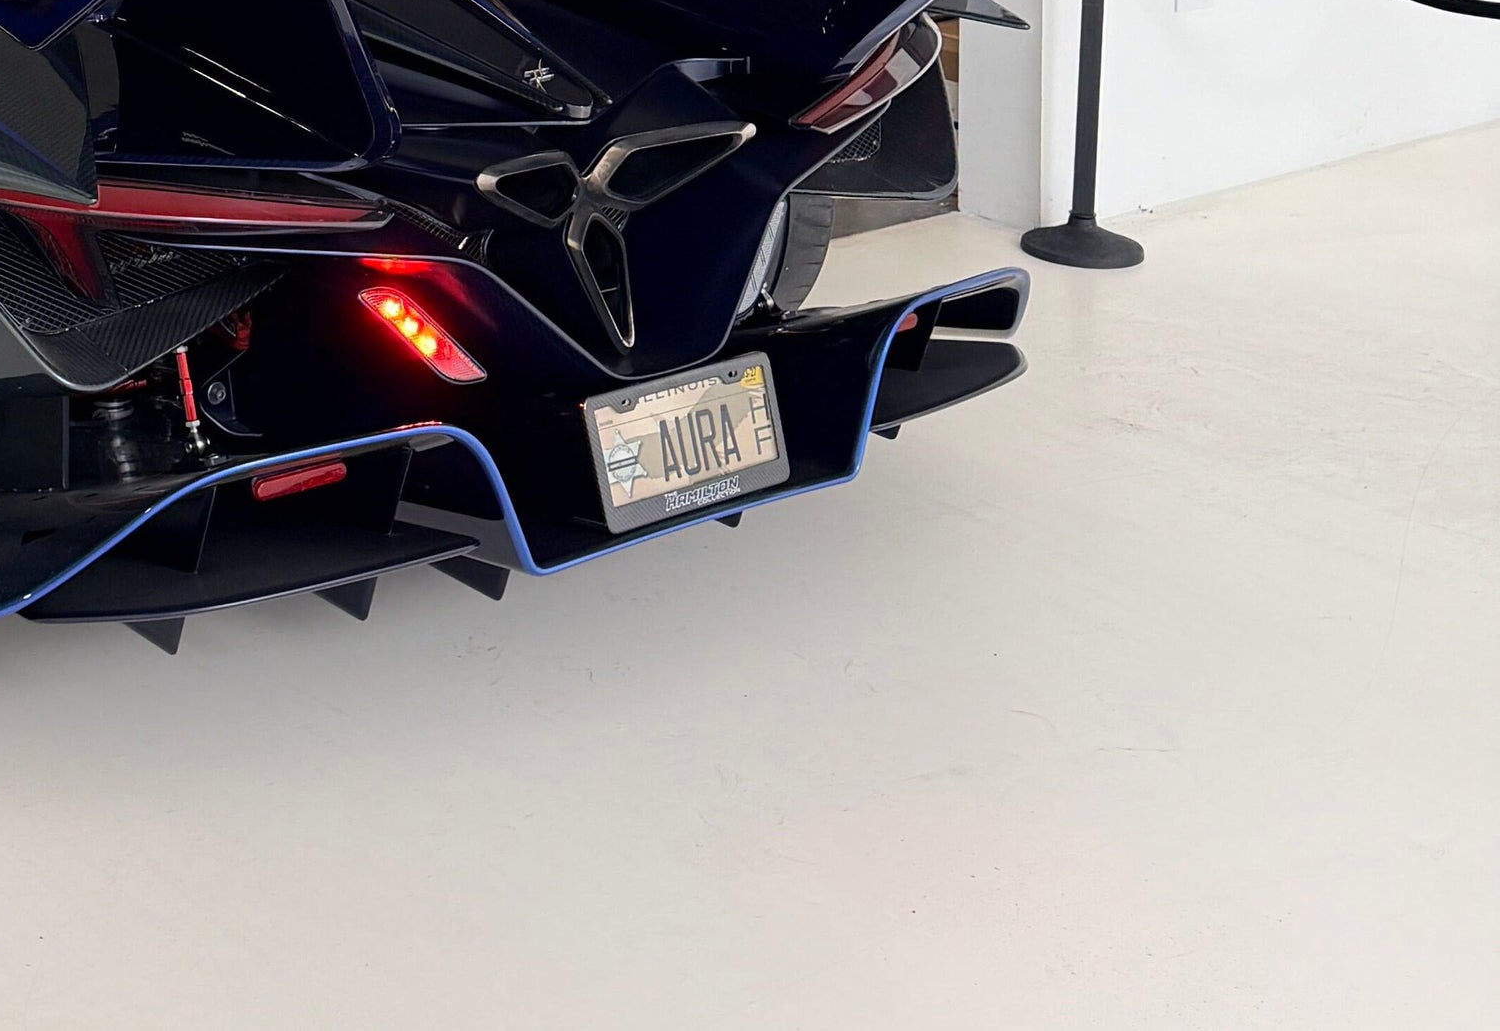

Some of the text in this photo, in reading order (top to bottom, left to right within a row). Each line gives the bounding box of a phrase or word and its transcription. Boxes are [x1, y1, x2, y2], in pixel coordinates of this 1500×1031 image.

[637, 377, 718, 404] LLINOIS
[659, 403, 742, 482] AURA
[665, 475, 740, 512] HAMILTON
